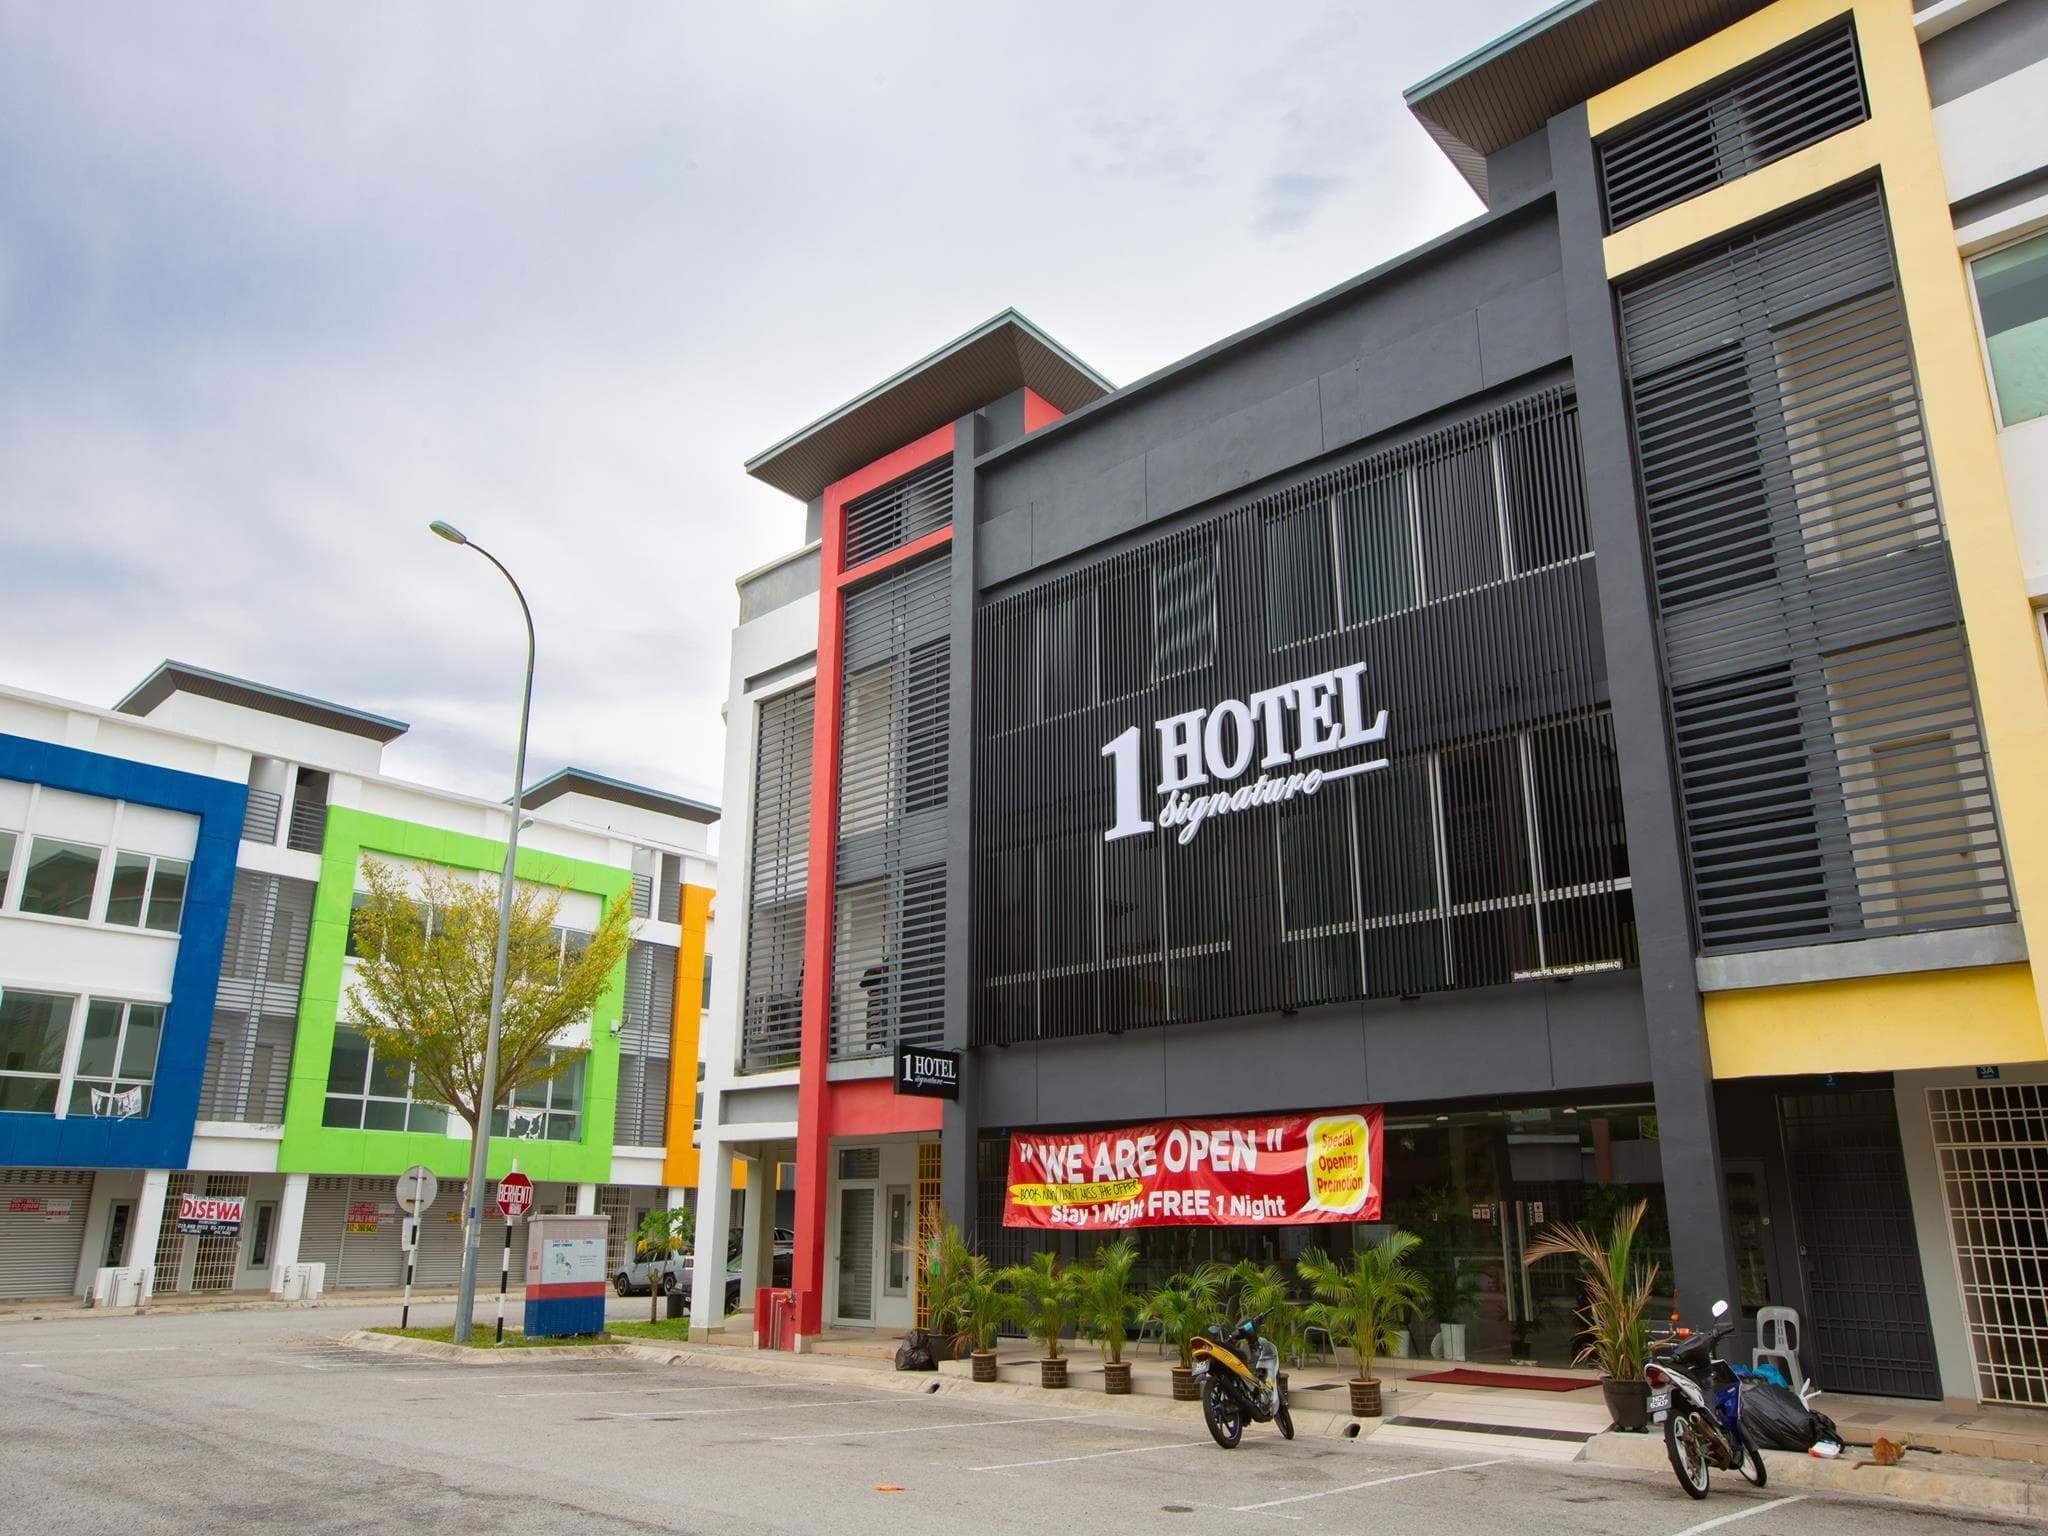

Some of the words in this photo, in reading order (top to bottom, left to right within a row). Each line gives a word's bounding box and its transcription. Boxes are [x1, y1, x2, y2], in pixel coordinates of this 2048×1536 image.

[1101, 725, 1154, 841] 1
[1155, 661, 1389, 794] HOTEL
[902, 1054, 913, 1082] 1
[914, 1055, 956, 1079] HOTEL
[1321, 1128, 1354, 1149] Special
[1093, 1135, 1158, 1183] ARE
[1318, 1151, 1359, 1173] Opening
[499, 1183, 532, 1205] BERHENTI
[1020, 1187, 1042, 1201] BOOK
[1317, 1176, 1364, 1194] Promotion
[180, 1199, 241, 1221] DISEWA
[1051, 1204, 1089, 1226] Stay
[1091, 1204, 1100, 1223] 1
[1103, 1199, 1145, 1225] Night
[1148, 1189, 1211, 1217] FREE
[1216, 1195, 1225, 1216] 1
[1230, 1194, 1287, 1221] Night
